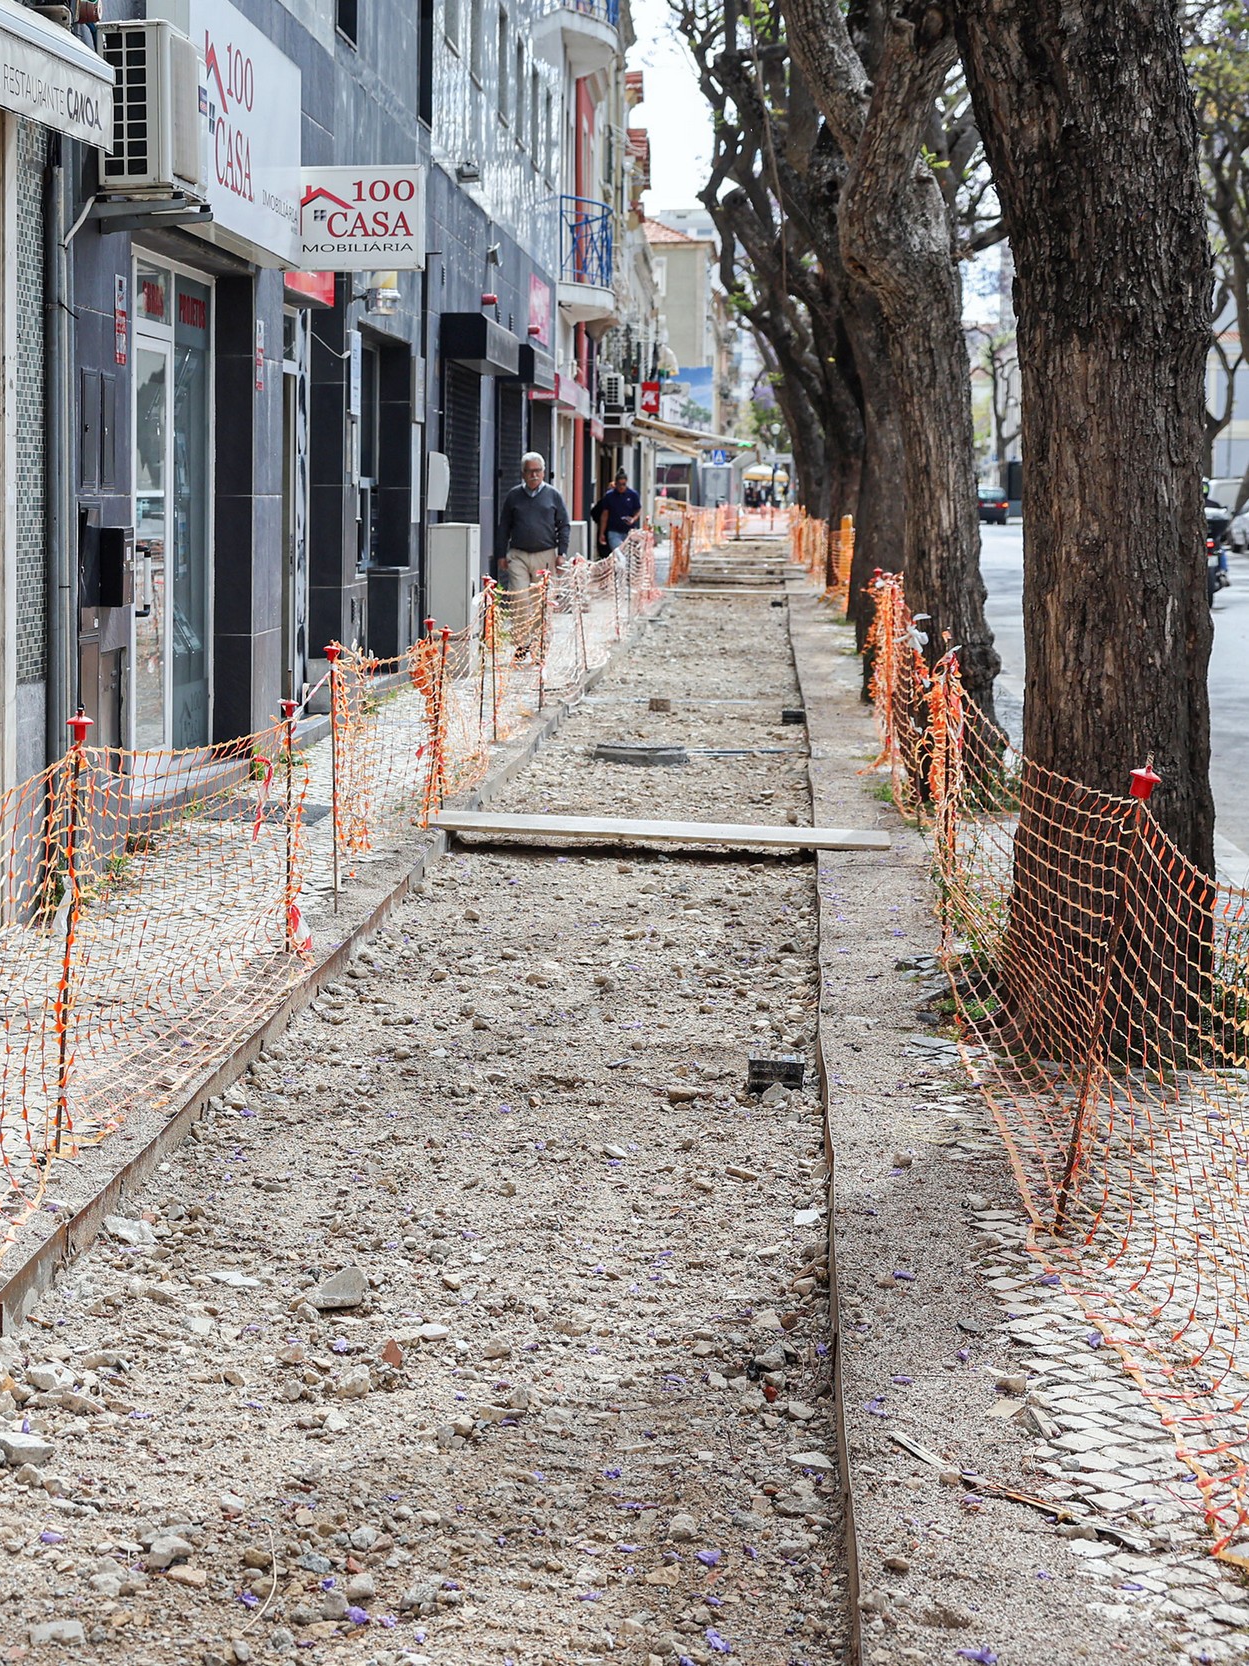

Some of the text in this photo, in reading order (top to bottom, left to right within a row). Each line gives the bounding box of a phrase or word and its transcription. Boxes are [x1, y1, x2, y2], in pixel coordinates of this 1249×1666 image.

[3, 63, 64, 115] RESTAURANTE
[67, 87, 102, 131] CANOA
[226, 42, 254, 112] 100
[215, 116, 253, 203] CASA
[352, 179, 415, 202] 100
[302, 241, 413, 253] MOBILIÁRIA
[327, 211, 414, 238] CASA
